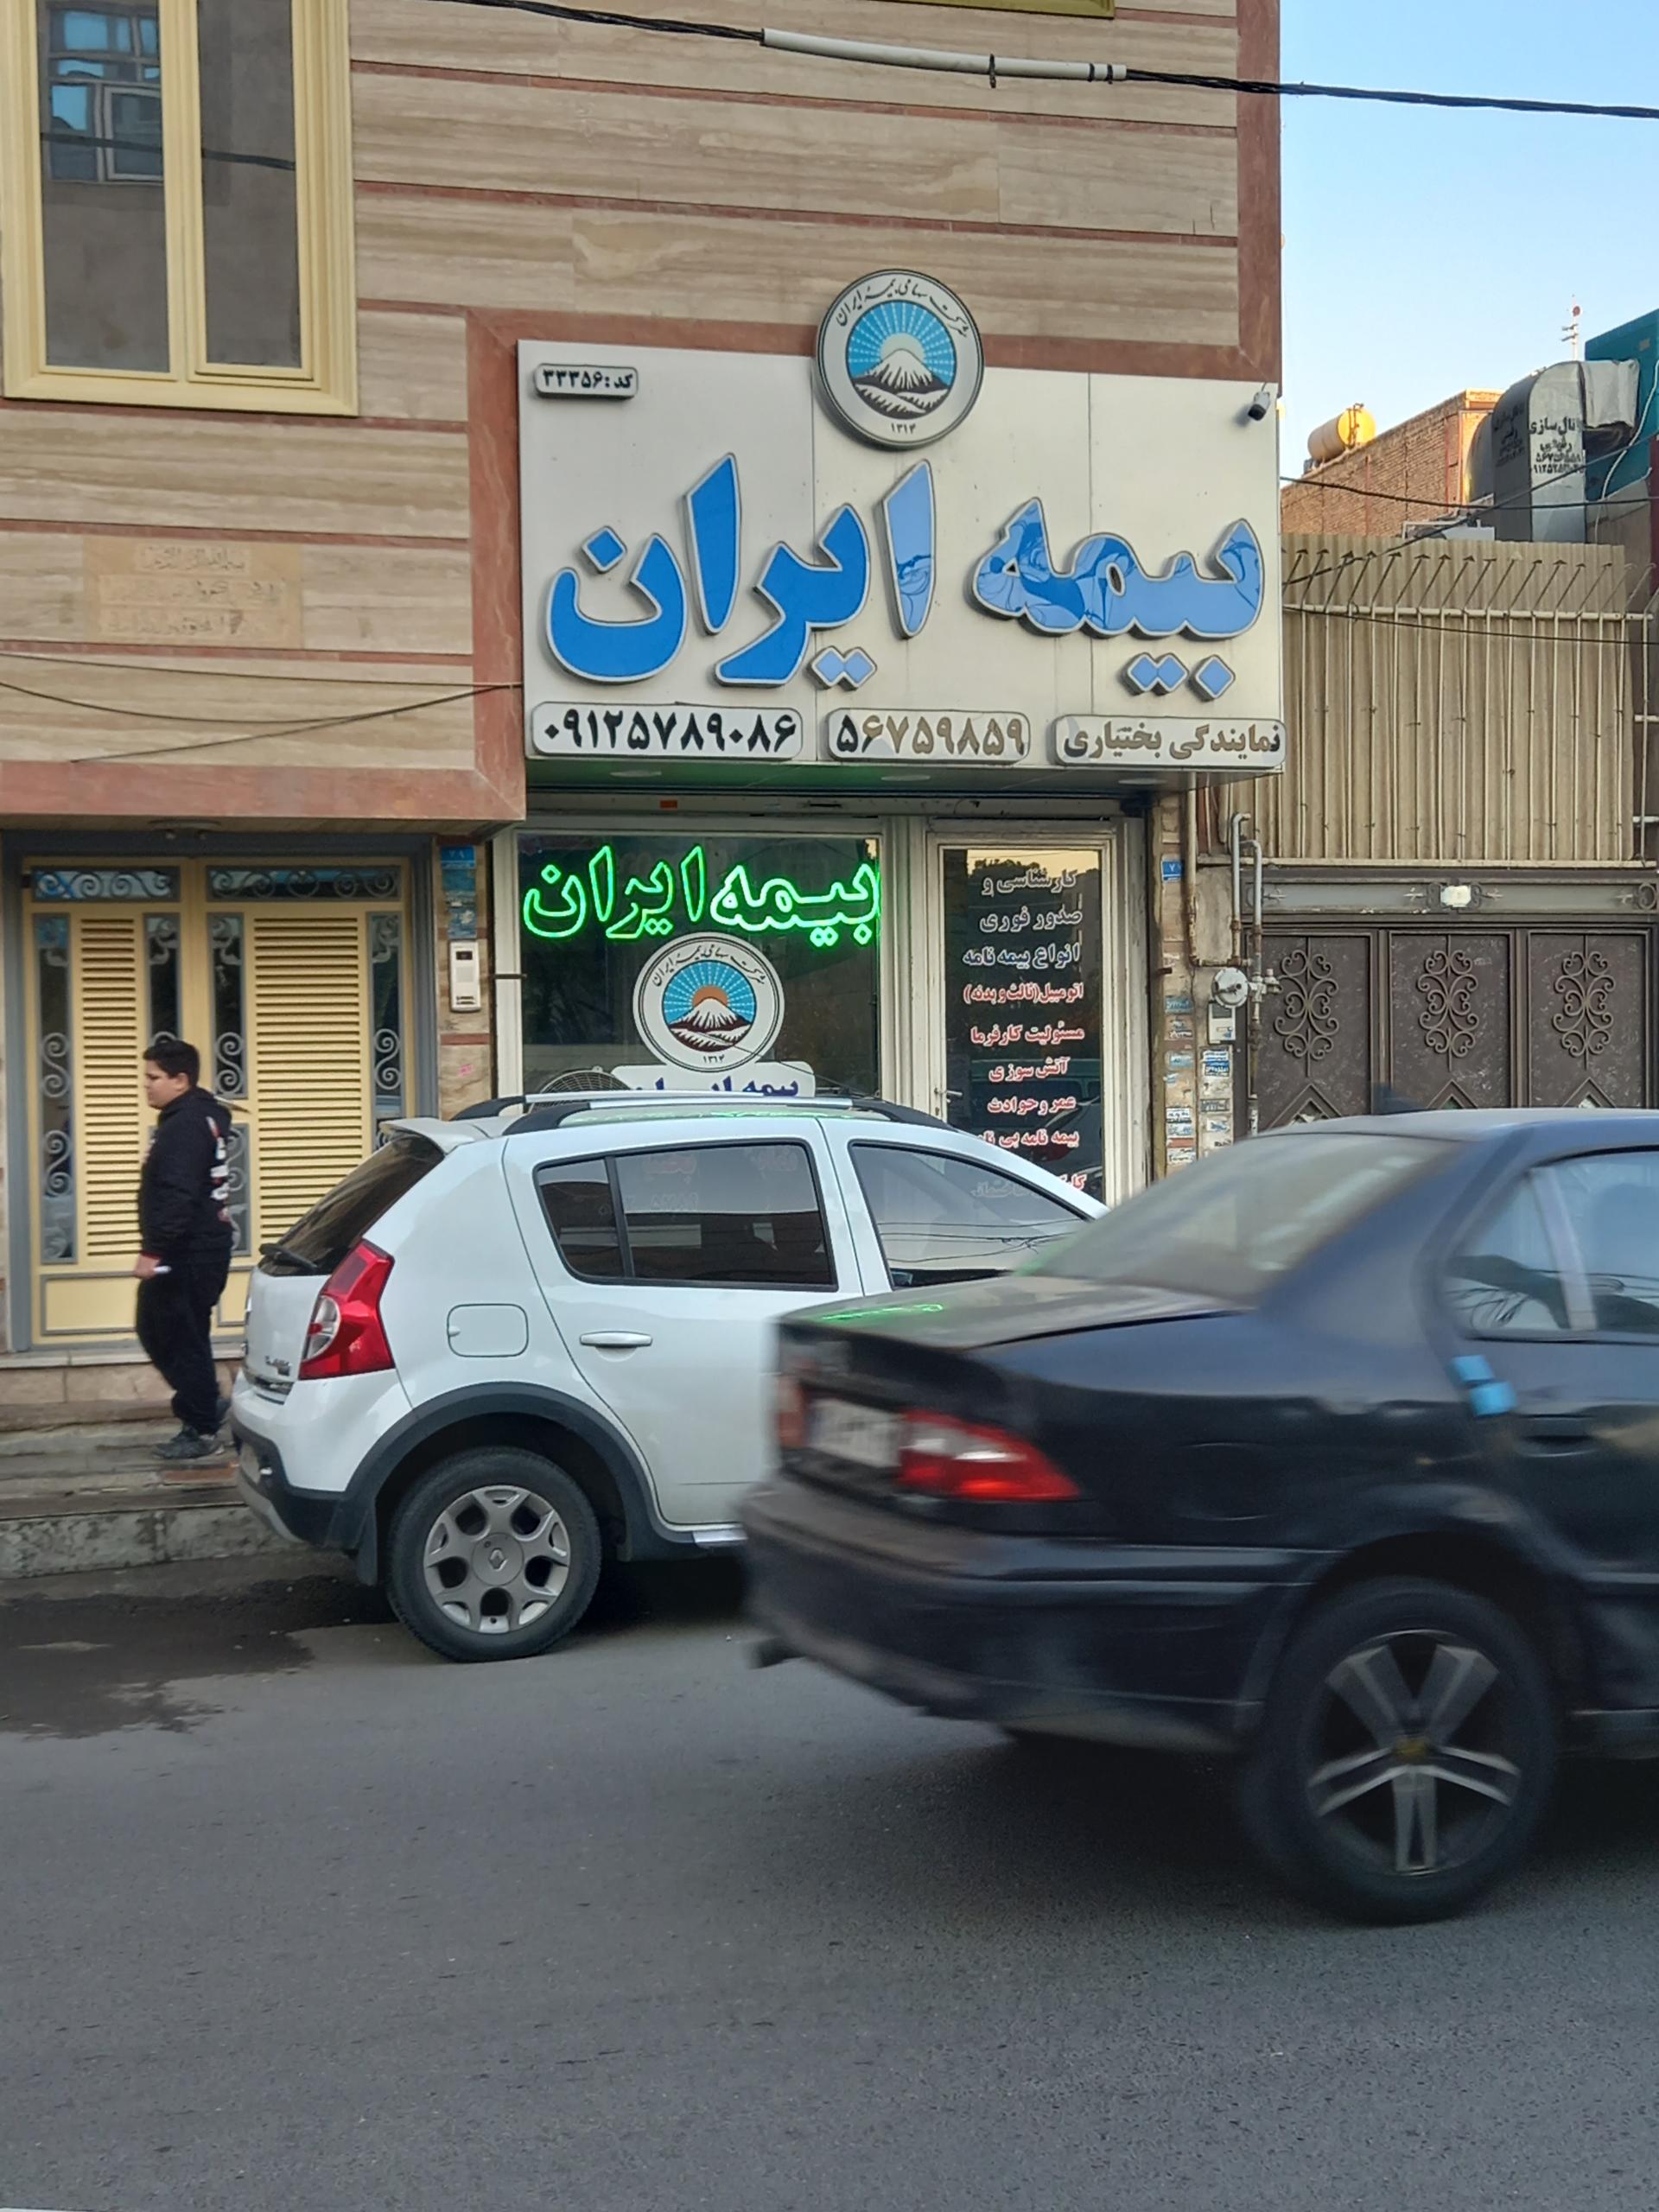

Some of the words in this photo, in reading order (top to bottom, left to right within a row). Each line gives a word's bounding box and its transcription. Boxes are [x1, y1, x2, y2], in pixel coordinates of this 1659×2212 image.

[544, 452, 936, 690] ایران
[969, 496, 1264, 700] بیمه
[543, 708, 797, 753] ۰۹۱۲۵۷۸۹۰۸۶
[836, 714, 1026, 756] ۵۶۷۵۹۸۵۹
[1063, 720, 1163, 759] بختیاری
[1168, 723, 1281, 760] نمایندگی
[522, 843, 706, 940] ایران
[981, 876, 995, 898] و
[996, 866, 1078, 893] کارشناسی
[709, 862, 880, 947] بیمه
[1032, 903, 1084, 931] صدور
[978, 905, 1031, 933] فوری
[962, 945, 995, 967] نامه
[996, 948, 1031, 970] بیمه
[1032, 941, 1080, 969] انواع
[969, 1023, 1024, 1047] کارفرما
[1024, 1020, 1085, 1046] مسئولیت
[988, 1063, 1034, 1084] سوزی
[1036, 1056, 1071, 1078] آتش
[987, 1095, 1039, 1116] حوادث
[1049, 1096, 1077, 1114] عمر
[998, 1130, 1020, 1148] بی
[1020, 1128, 1049, 1147] نامه
[1051, 1129, 1080, 1148] بیمه
